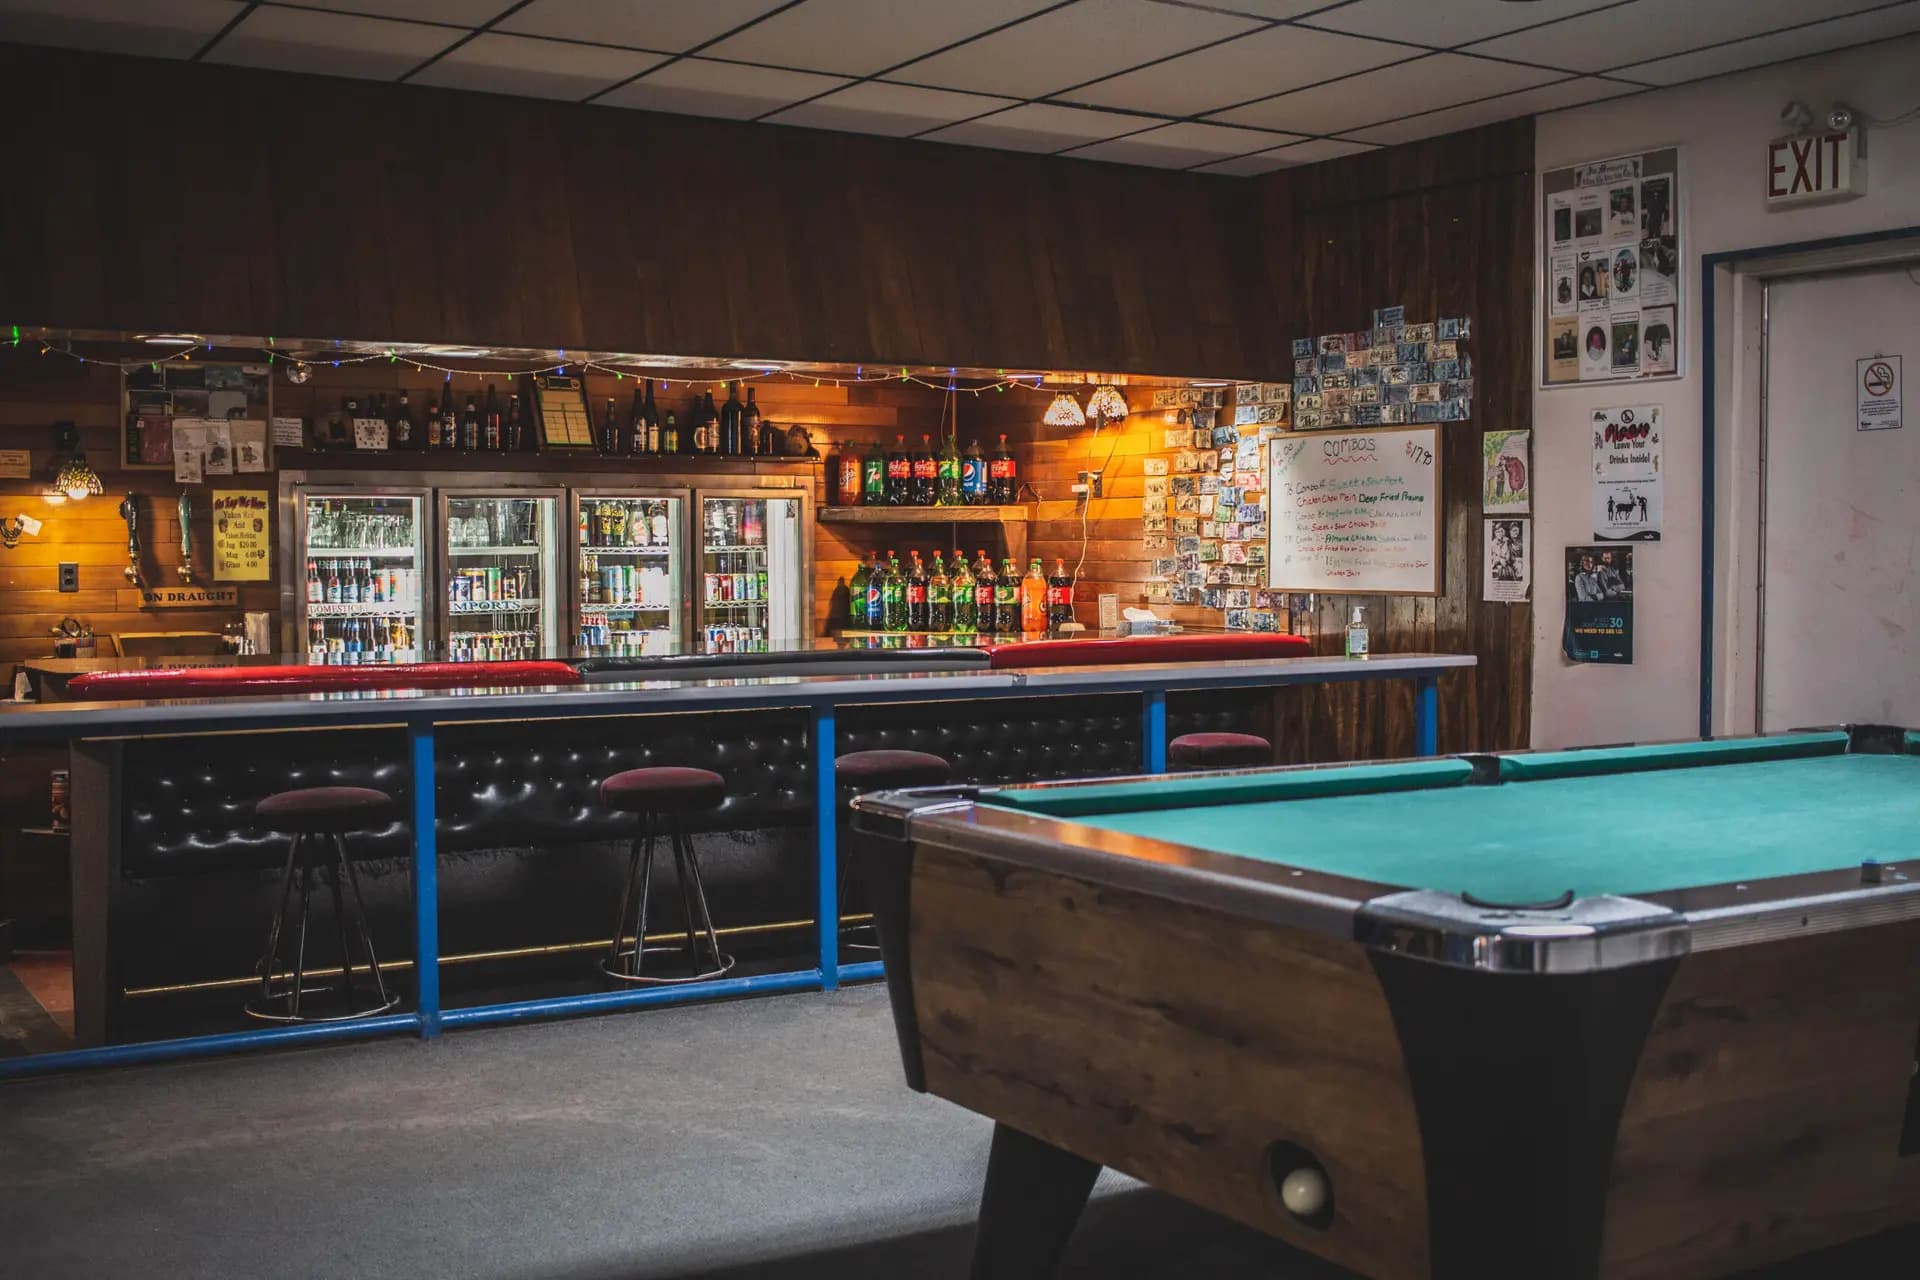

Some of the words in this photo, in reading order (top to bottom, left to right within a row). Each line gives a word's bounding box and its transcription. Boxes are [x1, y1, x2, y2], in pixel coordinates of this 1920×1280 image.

[1769, 132, 1847, 197] EXIT
[1323, 438, 1376, 457] COMBOS
[1632, 440, 1645, 449] Your
[1609, 455, 1629, 464] Drinks
[1358, 493, 1377, 504] Deep
[1377, 491, 1400, 501] Fried
[233, 521, 245, 529] And
[226, 542, 236, 550] Jug
[167, 591, 235, 601] DRAUGHT
[1608, 617, 1624, 628] 30
